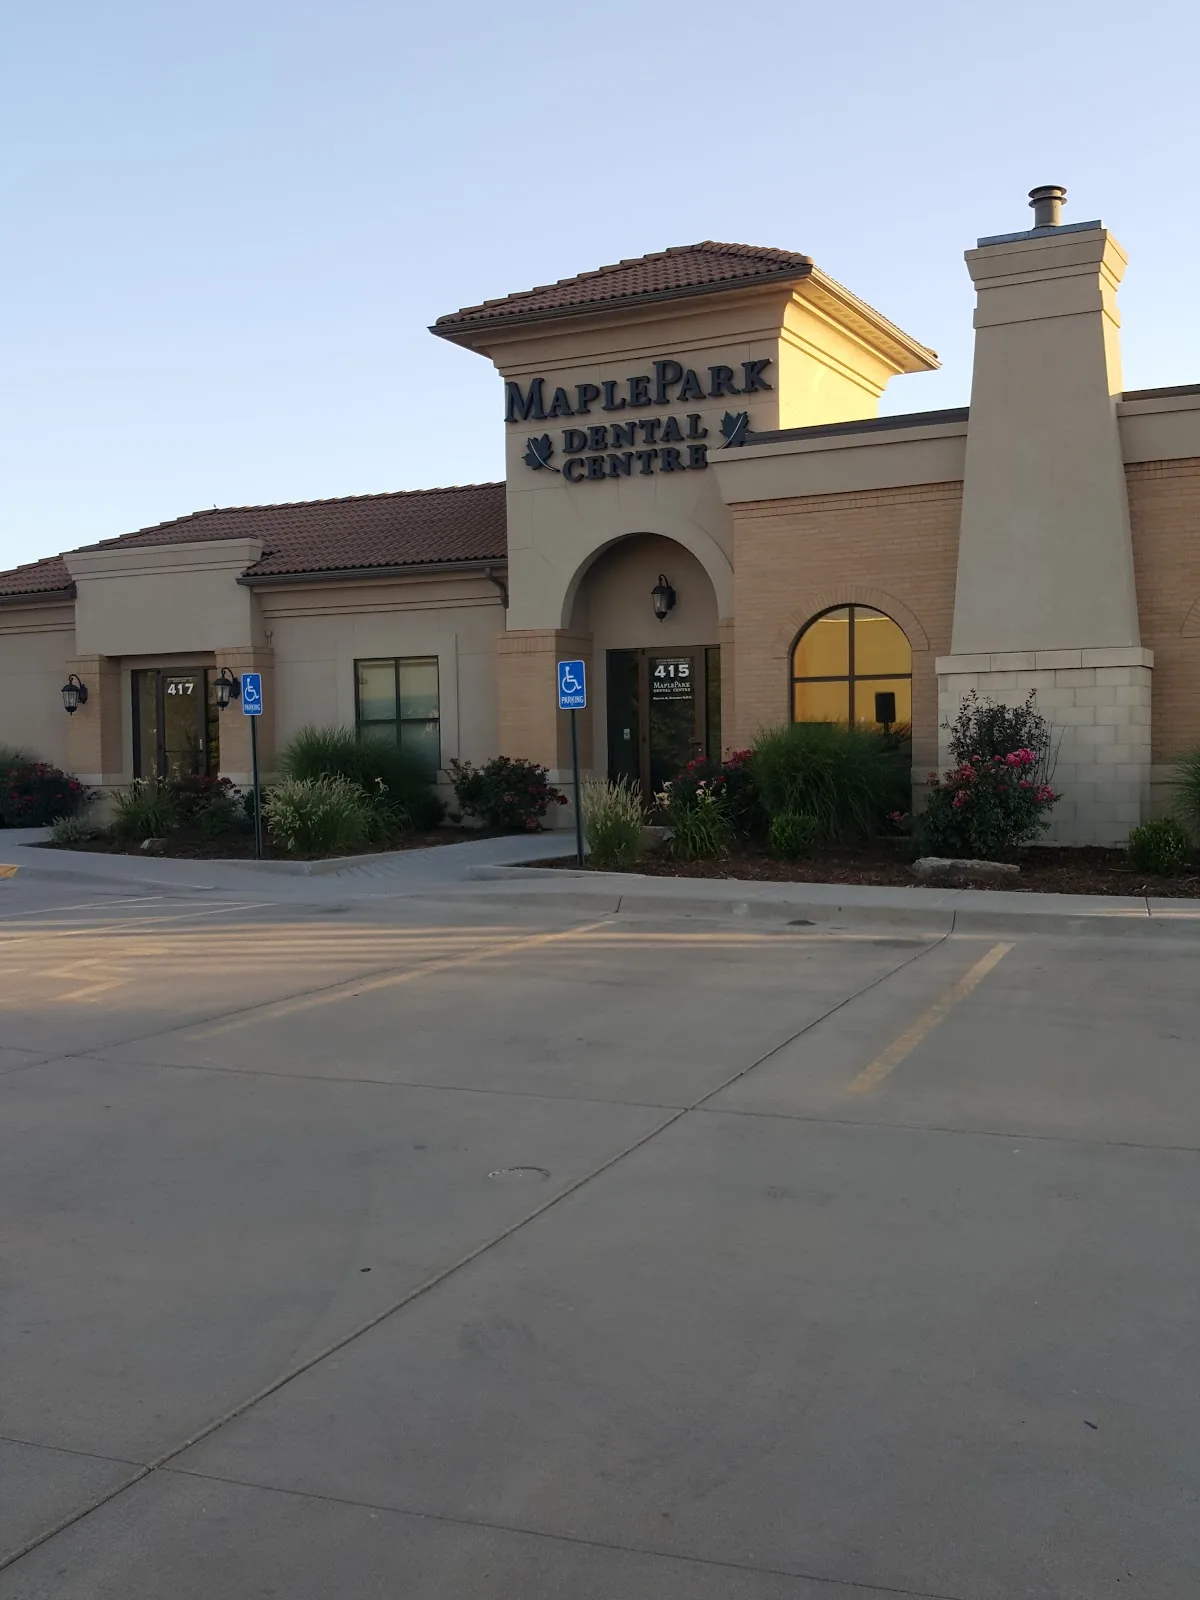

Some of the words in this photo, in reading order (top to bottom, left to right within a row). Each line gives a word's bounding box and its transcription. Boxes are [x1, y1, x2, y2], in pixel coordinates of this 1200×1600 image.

[562, 414, 708, 453] DENTAL
[562, 444, 709, 482] CENTRE
[654, 664, 690, 678] 415
[167, 683, 194, 695] 417
[561, 695, 584, 705] PARKING
[244, 703, 261, 711] PARKING
